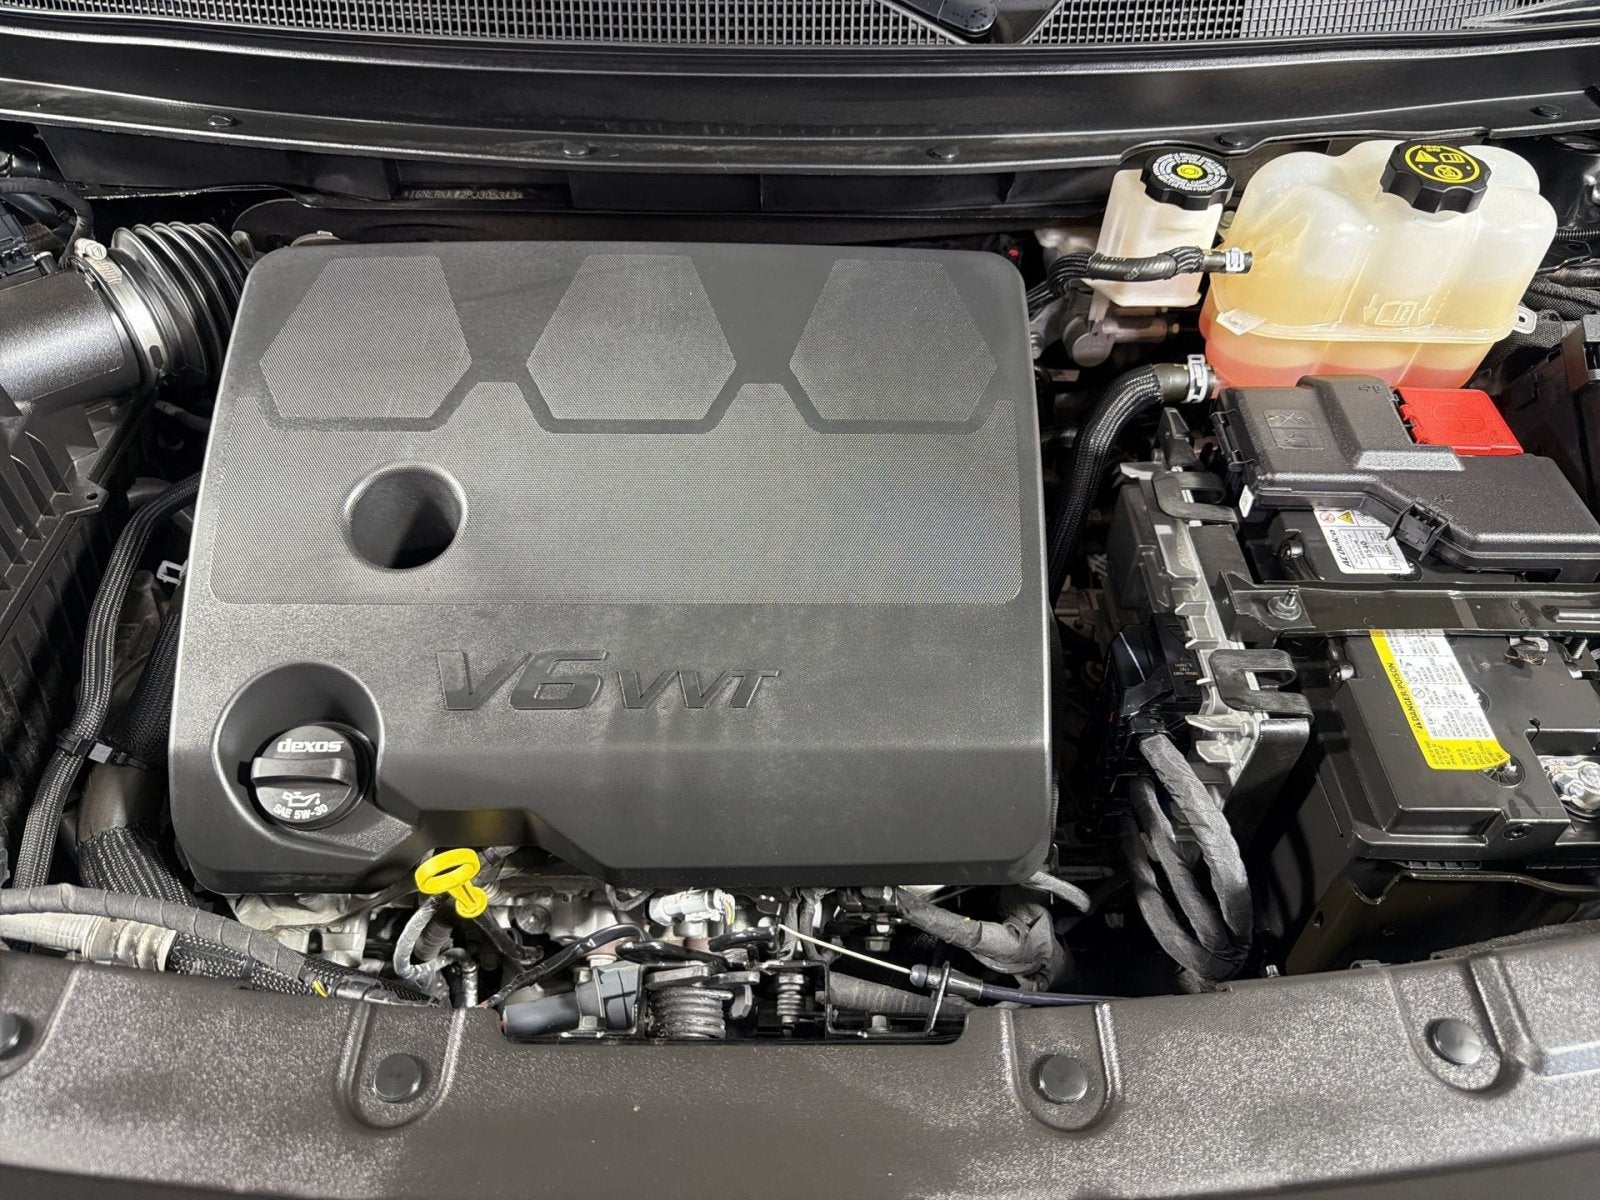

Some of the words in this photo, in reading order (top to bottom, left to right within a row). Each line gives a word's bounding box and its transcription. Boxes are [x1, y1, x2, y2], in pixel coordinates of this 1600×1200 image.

[1329, 529, 1352, 568] ACDelco
[437, 650, 609, 711] V6
[617, 669, 781, 710] VVT
[277, 738, 345, 753] dexos
[272, 803, 294, 819] SAE
[293, 803, 328, 820] 5W-30
